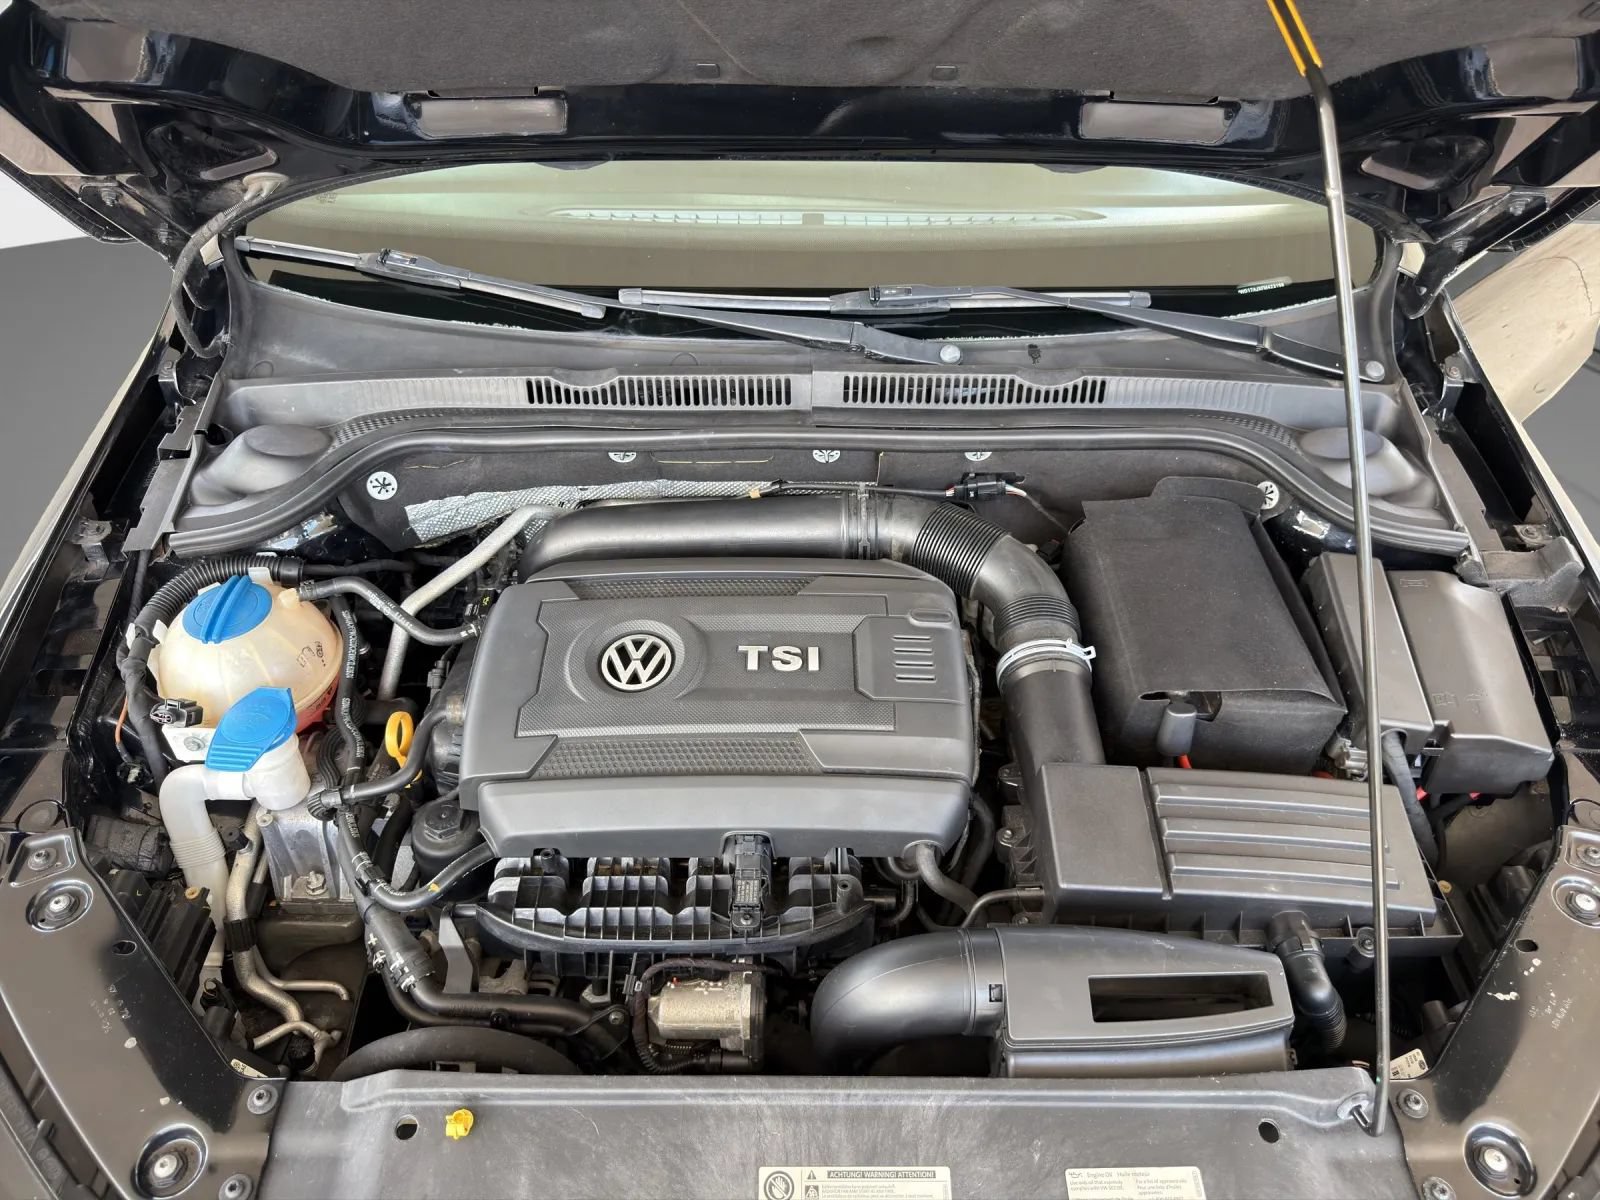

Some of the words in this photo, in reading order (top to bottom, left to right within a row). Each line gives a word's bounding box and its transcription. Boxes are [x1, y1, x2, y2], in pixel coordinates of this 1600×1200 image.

[602, 634, 671, 690] VW
[738, 645, 819, 671] TSI
[829, 1170, 863, 1178] ACHTUNG!
[864, 1170, 896, 1178] WARNING!
[897, 1170, 934, 1178] ATTENTION!
